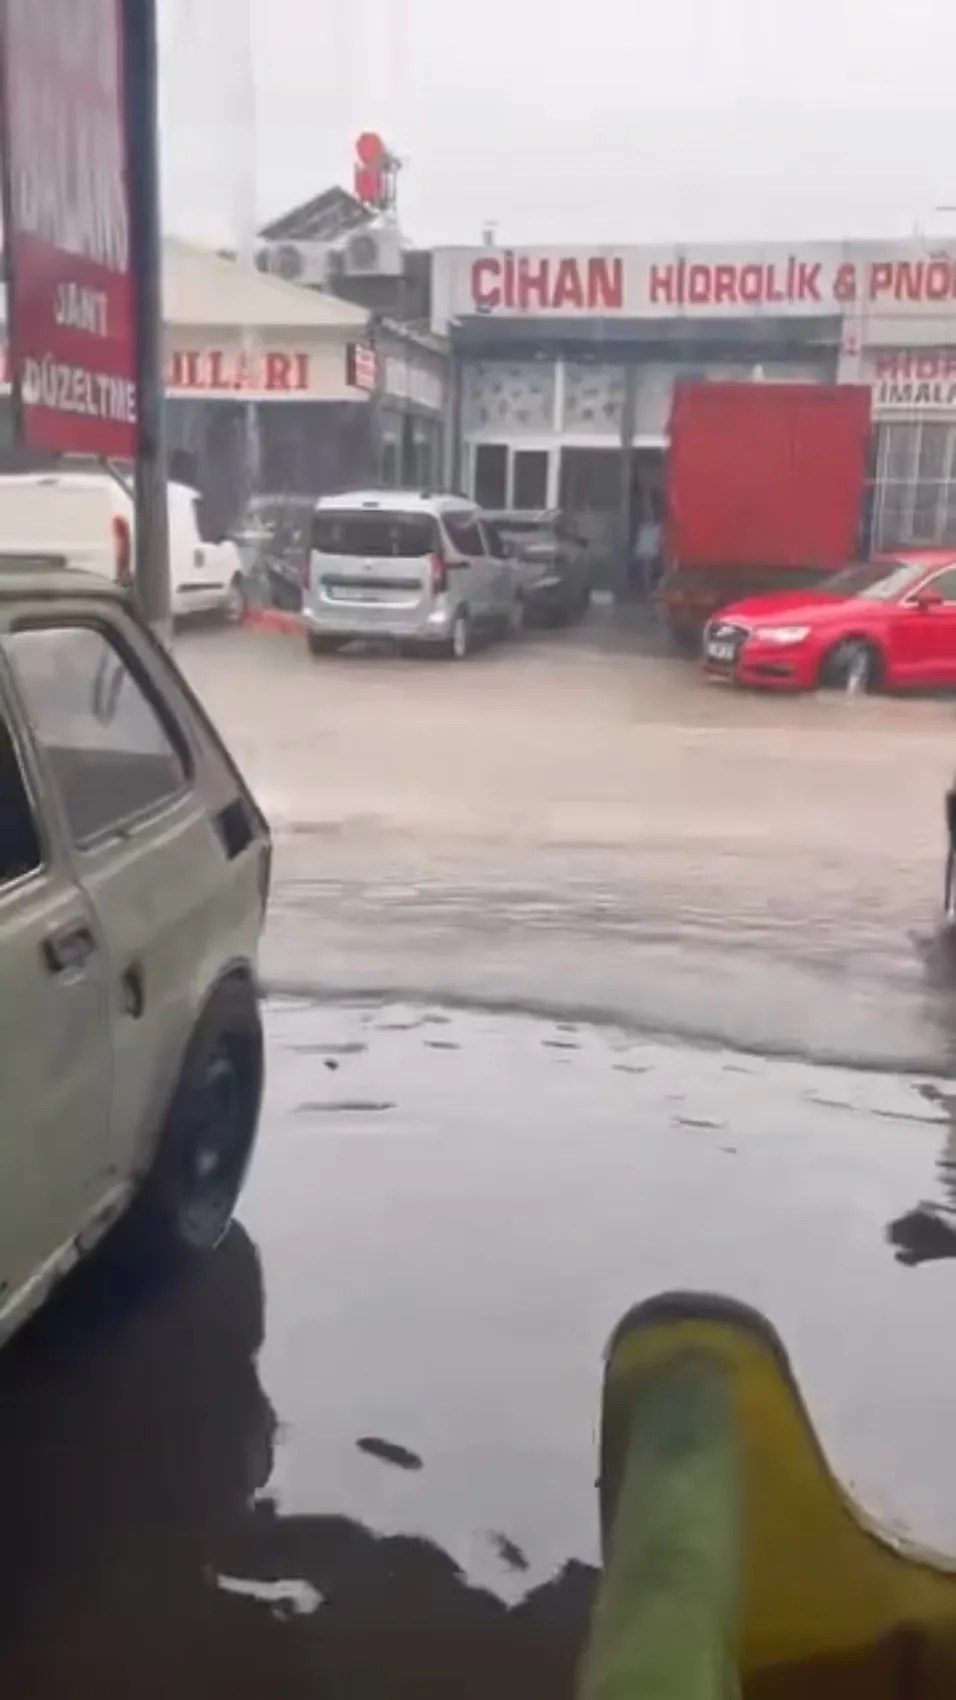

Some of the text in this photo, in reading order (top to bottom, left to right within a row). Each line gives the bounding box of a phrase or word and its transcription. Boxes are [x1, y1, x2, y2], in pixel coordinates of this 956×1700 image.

[53, 281, 108, 338] JANT
[471, 249, 623, 314] ÇİHAN
[833, 262, 857, 302] &
[21, 352, 138, 424] DÜZELTME
